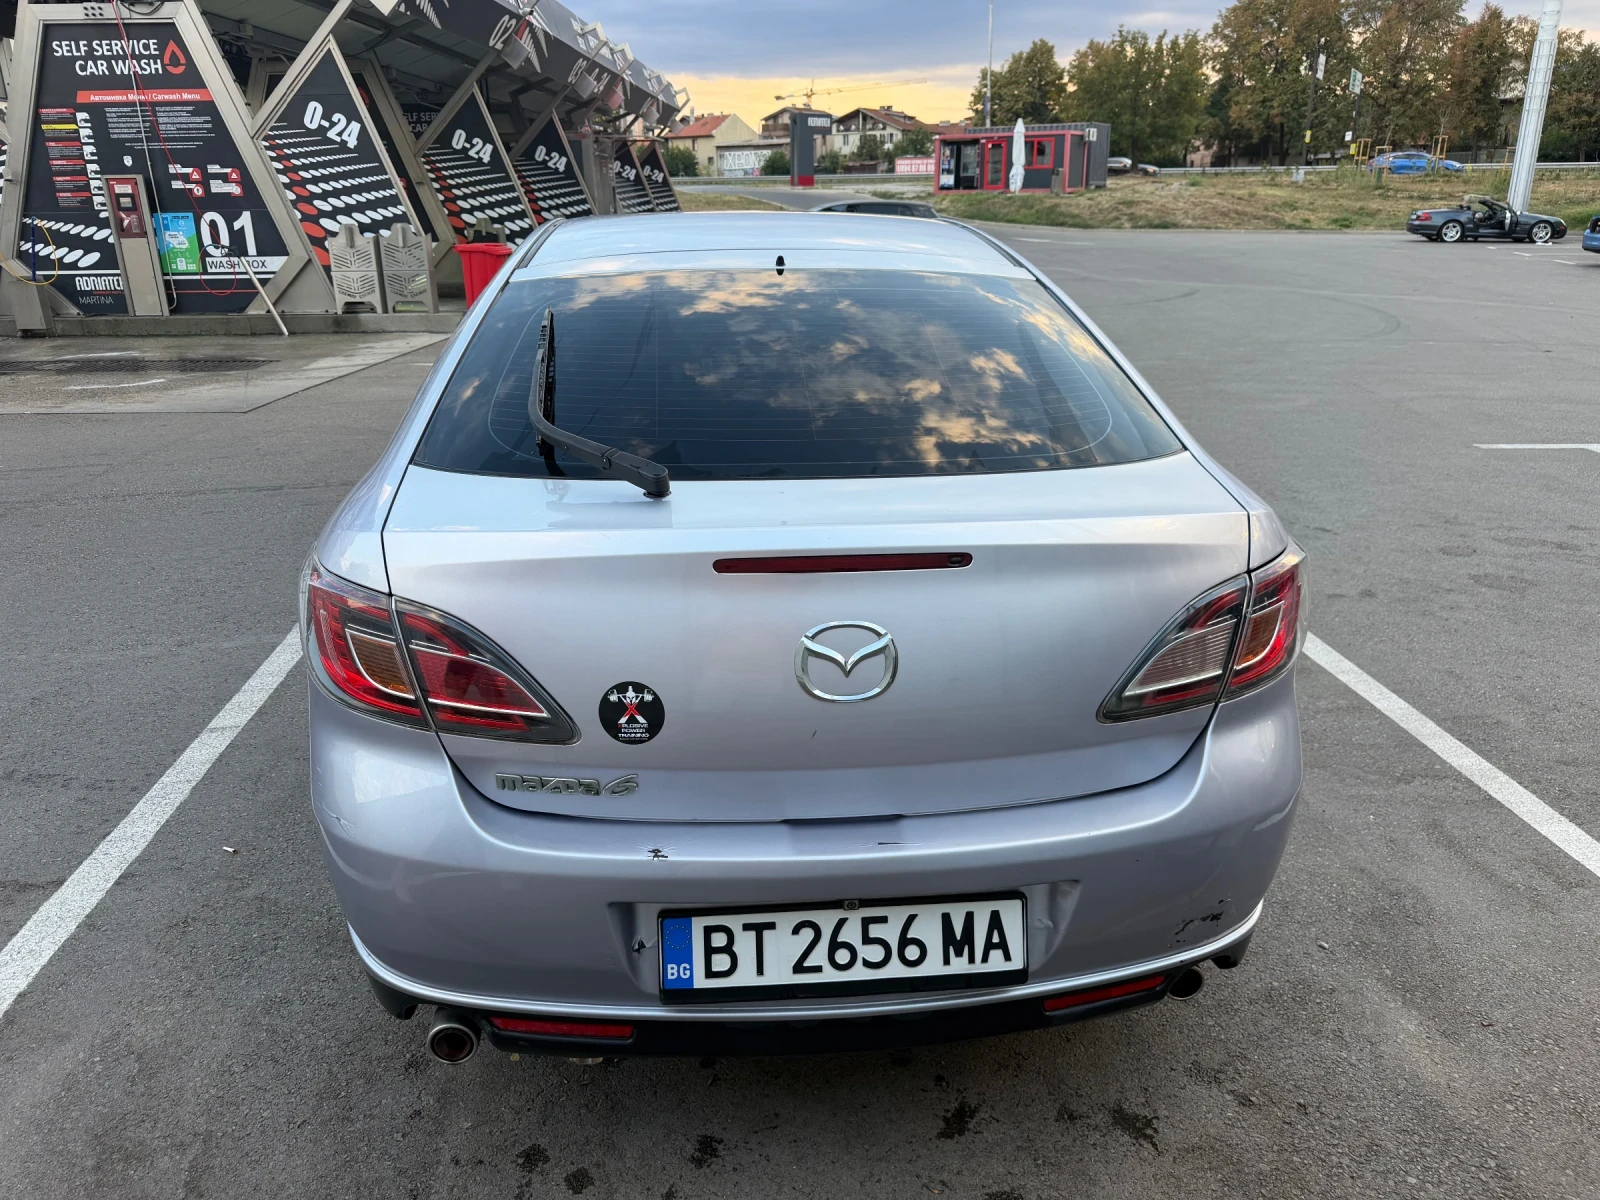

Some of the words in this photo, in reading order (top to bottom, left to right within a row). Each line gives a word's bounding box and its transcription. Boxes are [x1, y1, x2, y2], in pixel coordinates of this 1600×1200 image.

[52, 40, 89, 57] SELF
[92, 39, 160, 56] SERVICE
[75, 60, 109, 75] CAR
[112, 59, 163, 75] WASH
[182, 92, 201, 100] Menu
[303, 101, 361, 149] 0-24
[451, 129, 494, 164] 0-24
[534, 145, 568, 172] 0-24
[613, 161, 637, 181] 0-24
[643, 165, 665, 183] 0-24
[200, 211, 257, 257] 01
[207, 260, 241, 270] WASH
[79, 296, 114, 304] MARTINA
[602, 774, 639, 798] 6
[667, 963, 691, 980] BG
[703, 921, 776, 979] BT
[791, 913, 928, 974] 2656
[941, 910, 1013, 966] MA
